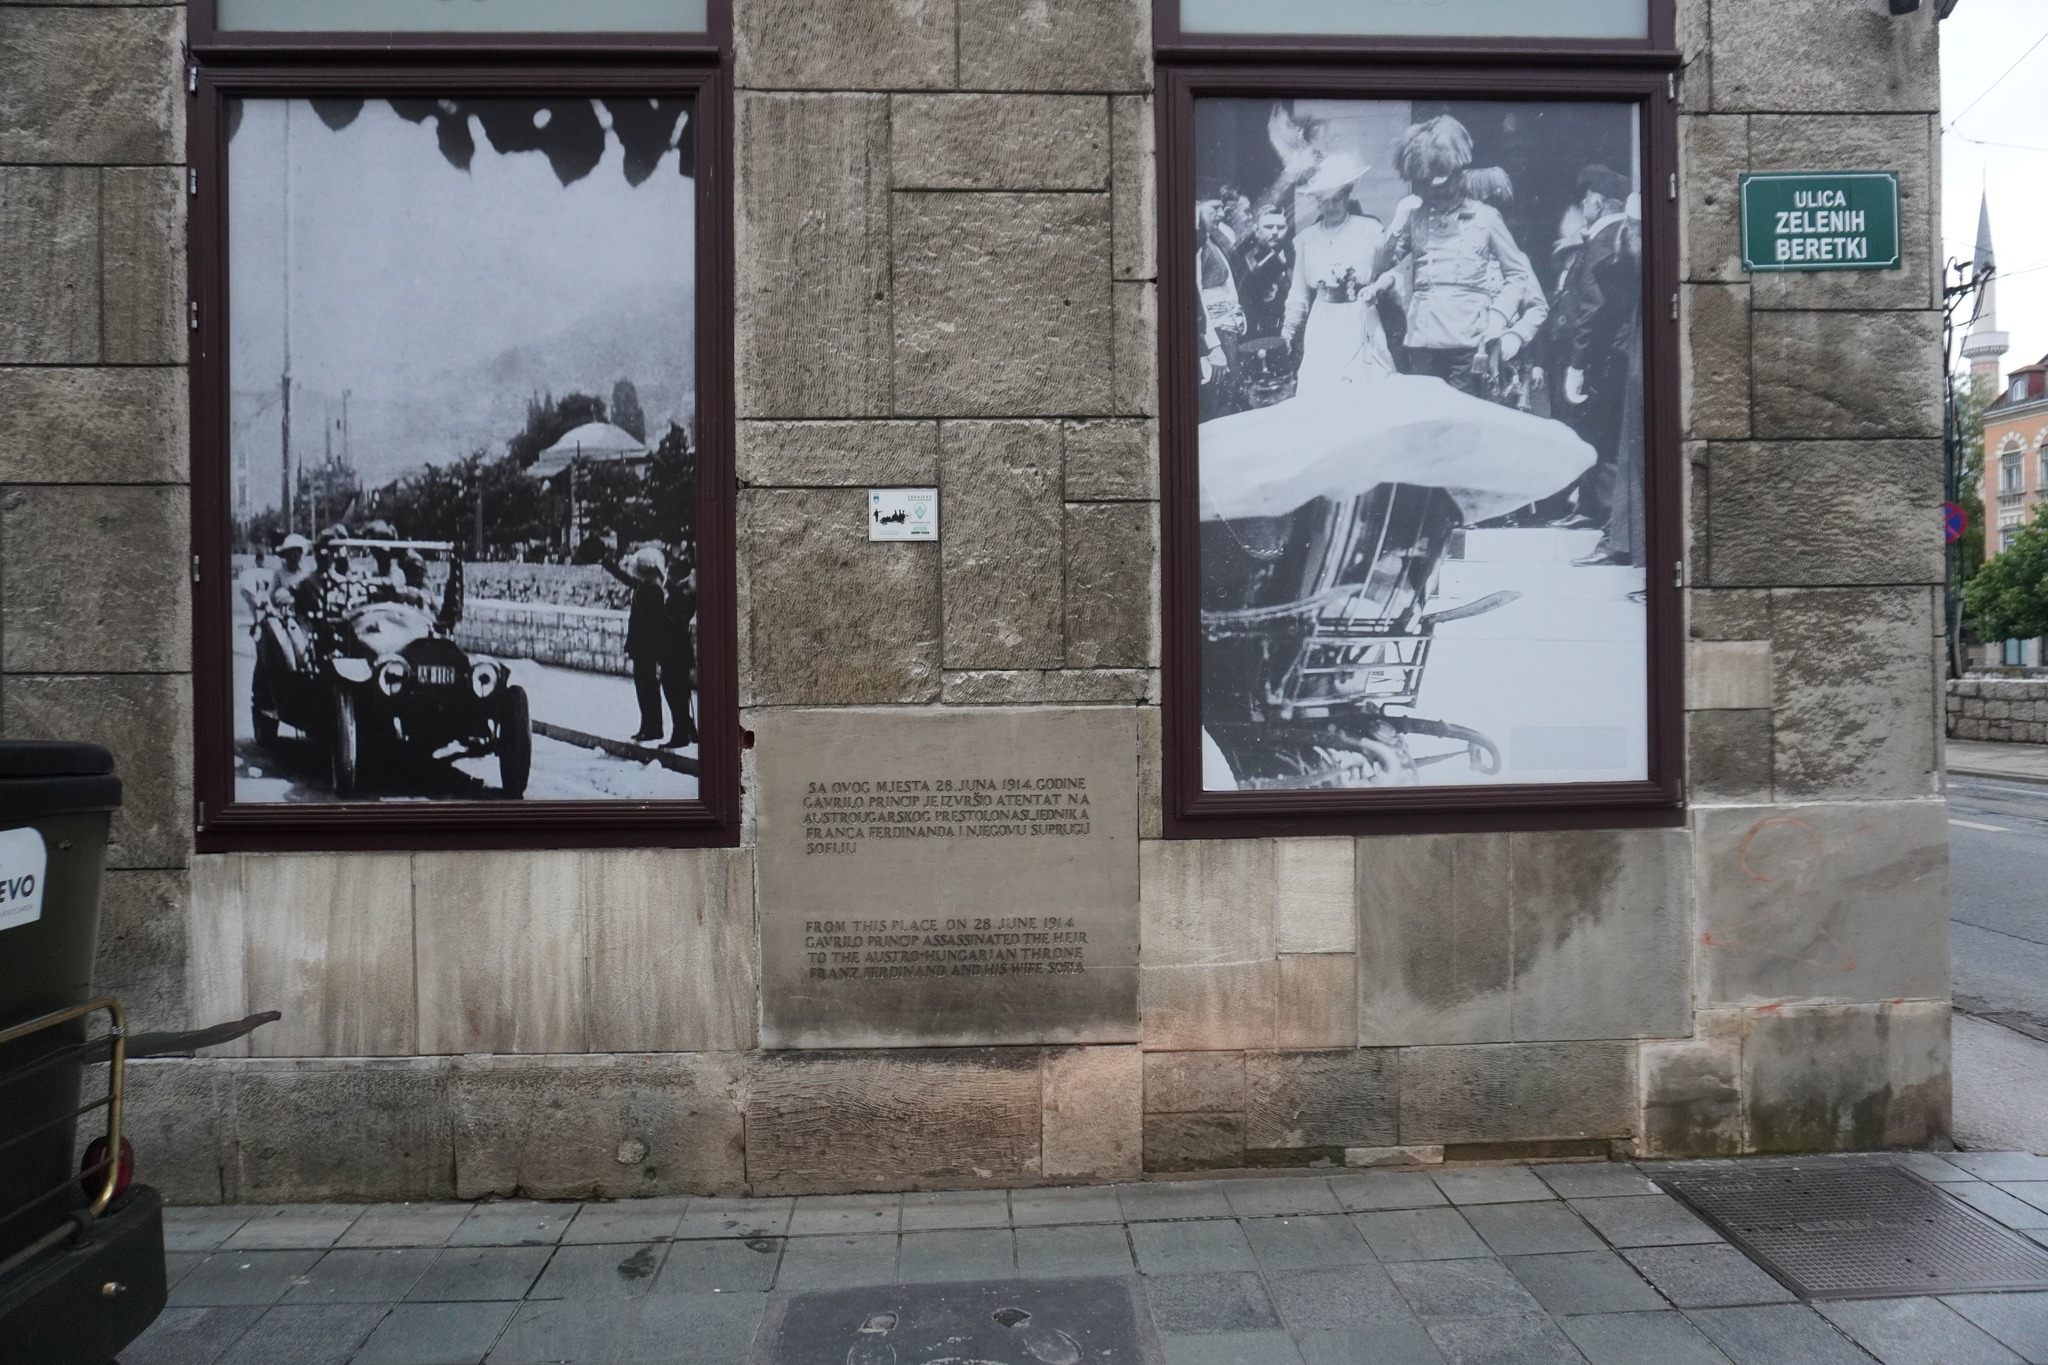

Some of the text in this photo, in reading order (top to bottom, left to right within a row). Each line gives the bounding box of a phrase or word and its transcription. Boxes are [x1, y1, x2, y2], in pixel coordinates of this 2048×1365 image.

[1795, 190, 1846, 208] ULICA
[1775, 210, 1865, 234] ZELENIH
[1775, 237, 1867, 261] BERETKI
[808, 782, 827, 794] SA
[832, 781, 870, 794] OVOG
[876, 780, 931, 793] MJESTA
[803, 796, 864, 809] GAVRILO
[868, 795, 920, 808] PRINCIP
[996, 794, 1062, 807] ATENTAT
[1068, 793, 1090, 806] NA
[803, 808, 1089, 825] AUSTROUGARSKOG PRESTOLONASLJEDNIKA
[806, 822, 1090, 839] FRANCA FERDINANDA I NJEGOVU SUPRUGU
[806, 842, 857, 855] SOFIJU
[805, 921, 846, 933] FROM
[852, 920, 887, 932] THIS
[892, 919, 938, 932] PLACE
[945, 919, 967, 931] ON
[974, 918, 991, 931] 28
[998, 917, 1037, 930] JUNE
[805, 931, 1088, 948] GAVRILO PRINCIP ASSASSINATED THE HEIR
[807, 947, 1083, 964] TO THE AUSTRO-HUNGARIAN THRONE
[809, 961, 1085, 980] FRANZ FERDINAND AND HIS WIFE SOFIA
